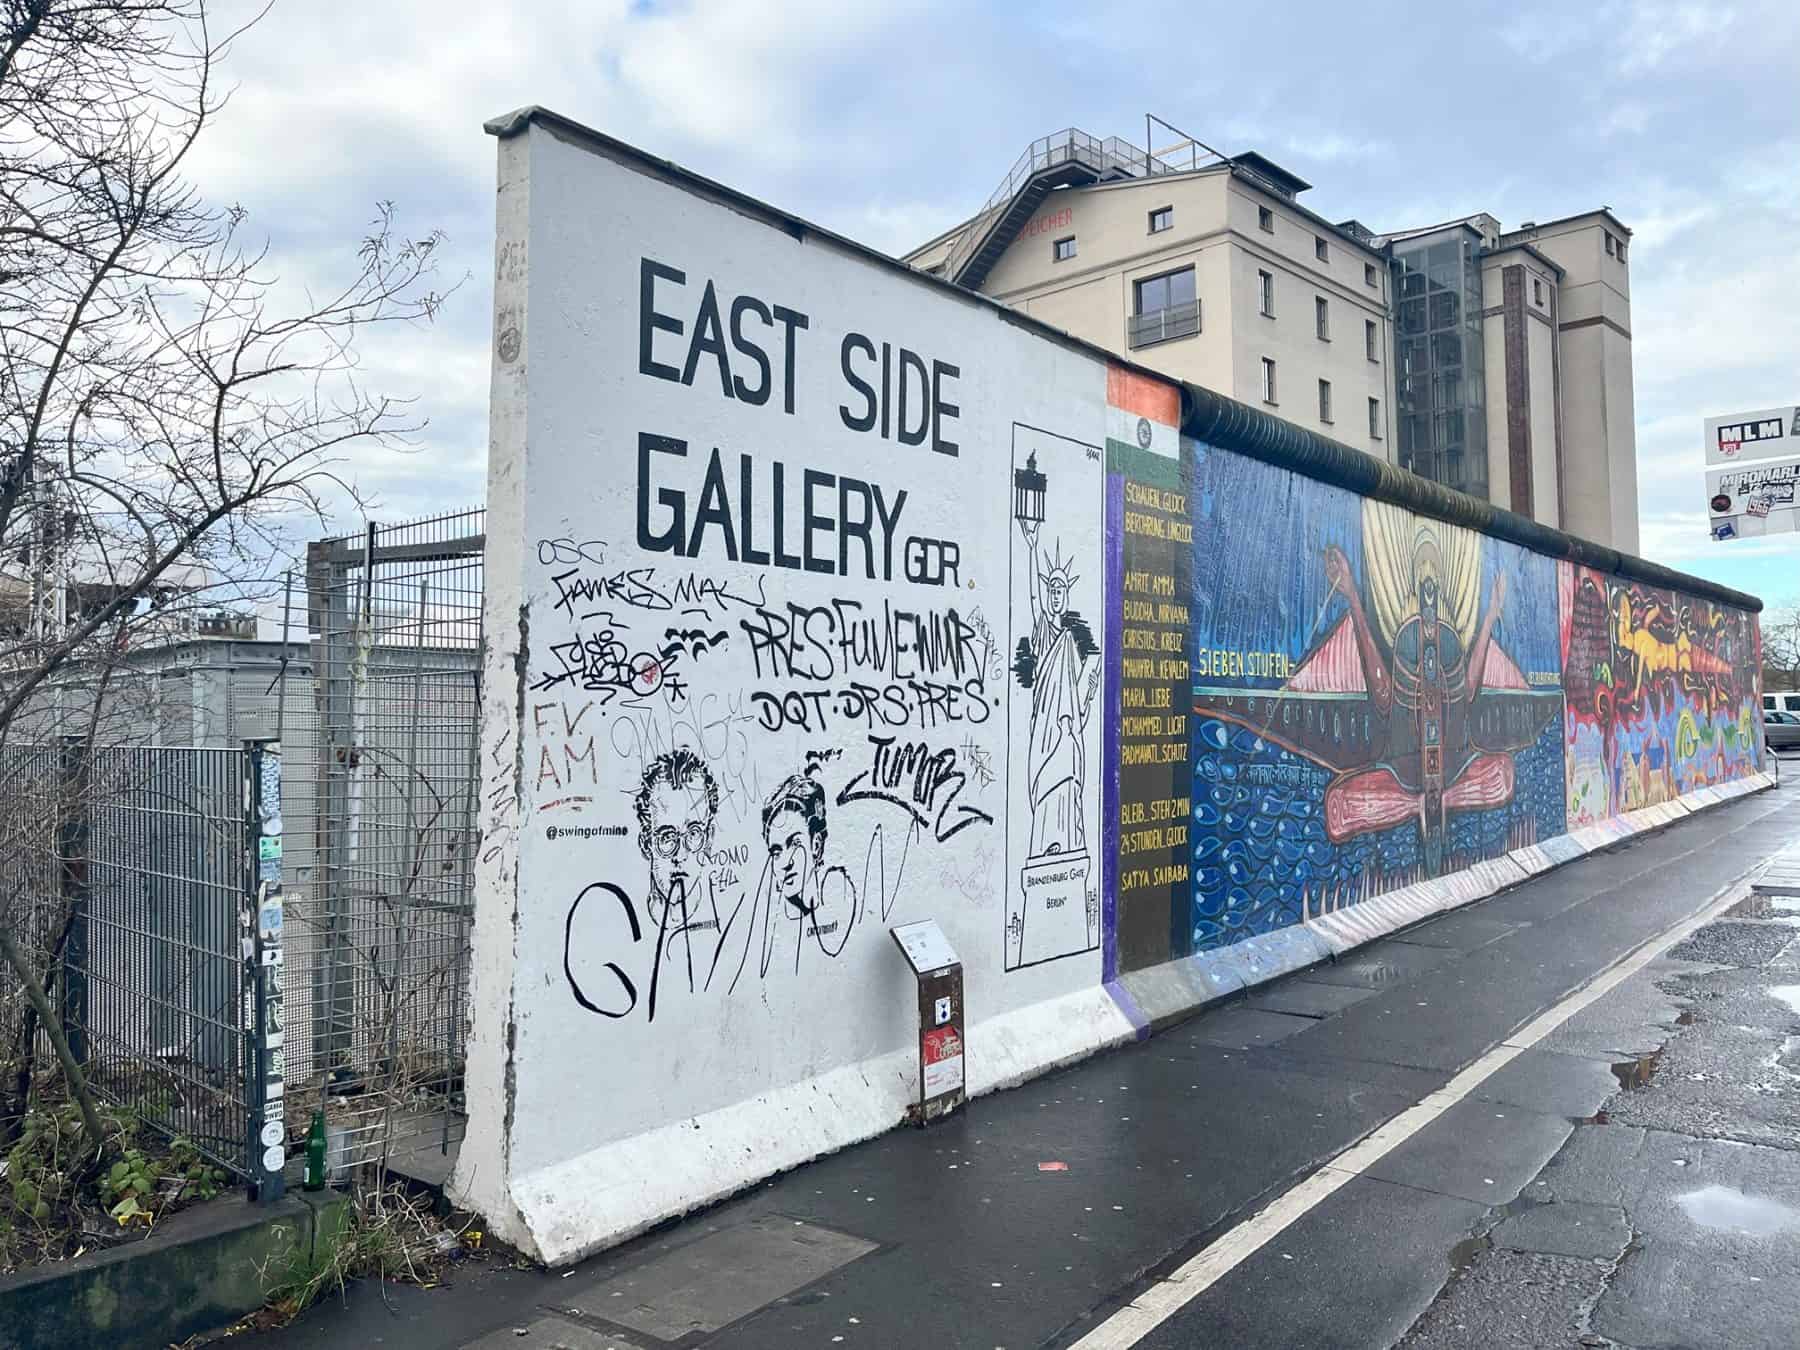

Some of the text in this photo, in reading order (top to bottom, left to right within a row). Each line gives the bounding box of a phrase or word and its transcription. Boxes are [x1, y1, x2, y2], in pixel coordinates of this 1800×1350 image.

[639, 257, 960, 457] EAST SIDE
[1720, 420, 1780, 443] MLM
[636, 432, 908, 582] GALLERY
[1199, 647, 1289, 678] SIEBEN STUFEN
[1026, 871, 1069, 888] BRANDENBURG
[1121, 864, 1188, 891] SATYA SAIBABA
